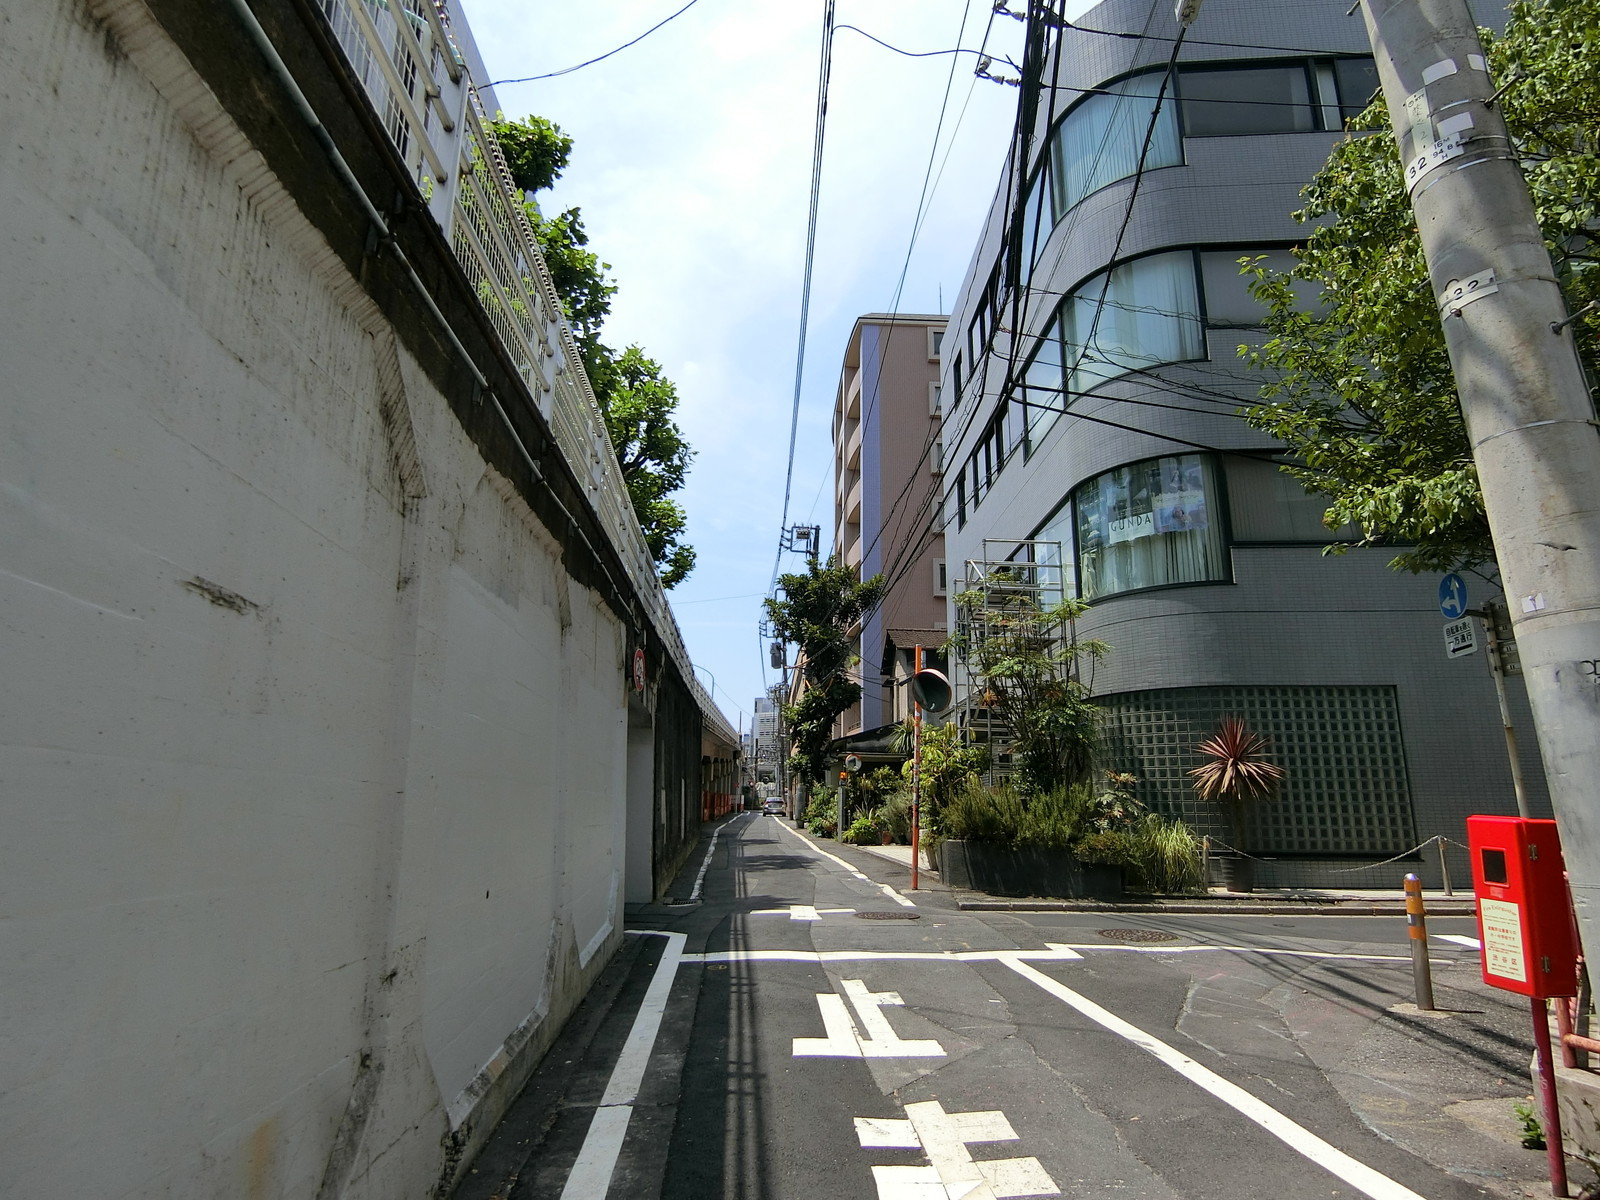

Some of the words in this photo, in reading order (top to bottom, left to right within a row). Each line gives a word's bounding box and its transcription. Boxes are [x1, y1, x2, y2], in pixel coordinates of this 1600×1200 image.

[1409, 156, 1427, 179] 32
[1110, 516, 1151, 532] GUNDA
[1448, 632, 1472, 645] 一方通行
